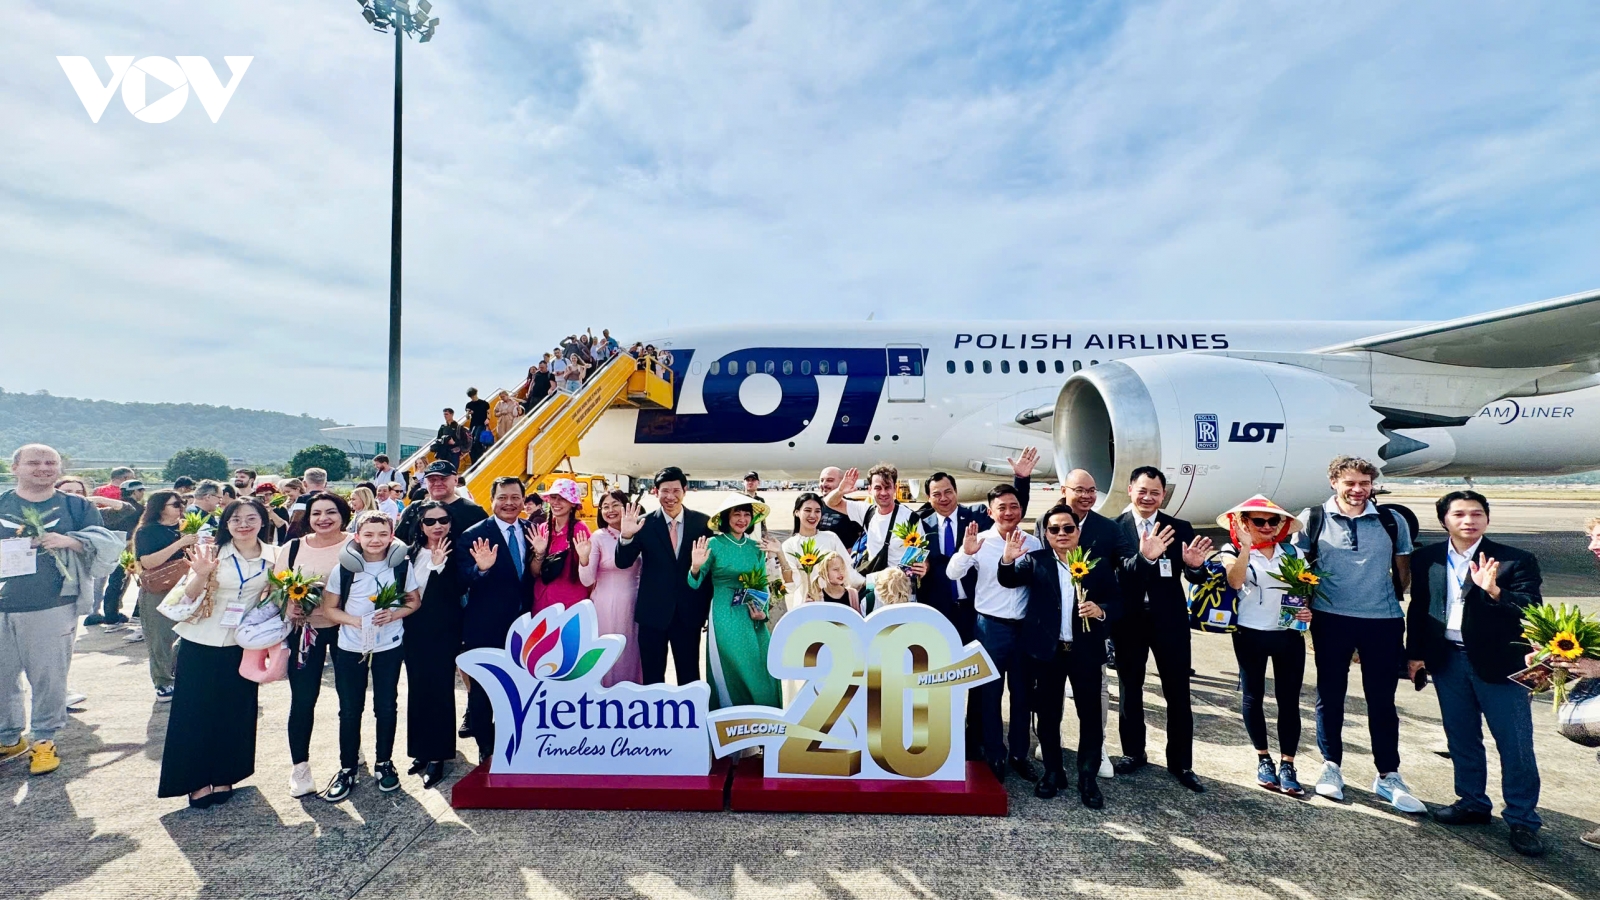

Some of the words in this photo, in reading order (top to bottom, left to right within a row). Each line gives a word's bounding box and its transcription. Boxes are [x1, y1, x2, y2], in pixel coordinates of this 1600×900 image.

[954, 333, 1073, 350] POLISH
[1084, 333, 1230, 350] AIRLINES
[634, 347, 930, 444] LOT
[1474, 403, 1575, 420] AMLINER
[1228, 421, 1285, 443] LOT
[725, 723, 787, 738] WELCOME
[778, 620, 952, 778] 20
[917, 663, 980, 686] MILLIONTH
[475, 663, 700, 766] Vietnam
[535, 733, 606, 758] Timeless
[610, 736, 673, 758] Charm
